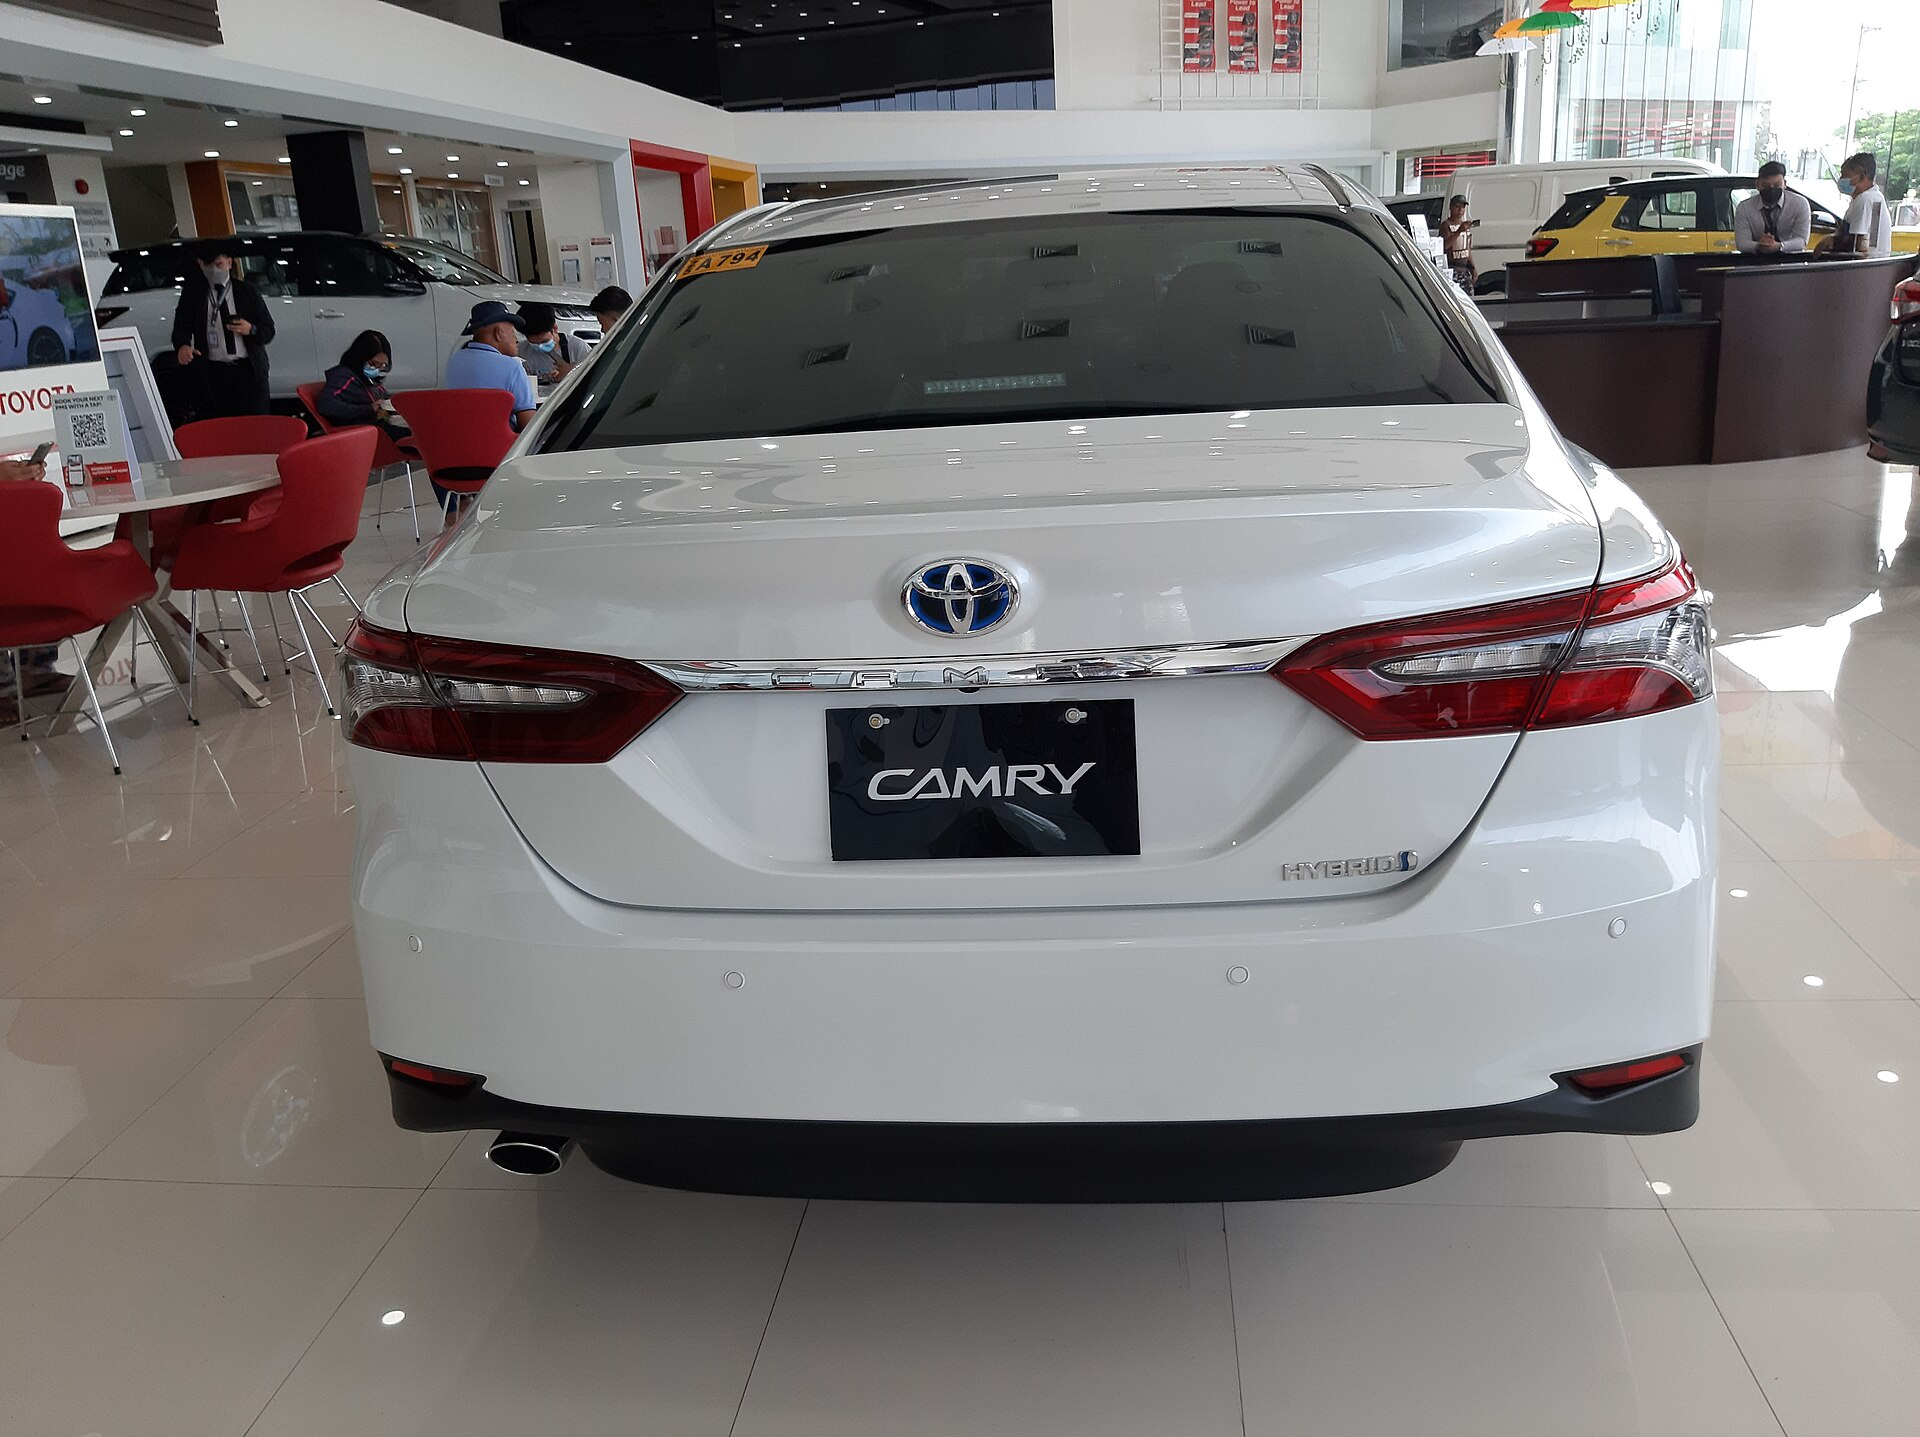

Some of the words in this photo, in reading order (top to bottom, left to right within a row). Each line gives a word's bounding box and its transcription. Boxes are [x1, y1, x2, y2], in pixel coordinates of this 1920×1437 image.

[717, 250, 761, 267] 794
[867, 762, 1097, 801] CAMRY
[1282, 855, 1397, 881] HYBRID
